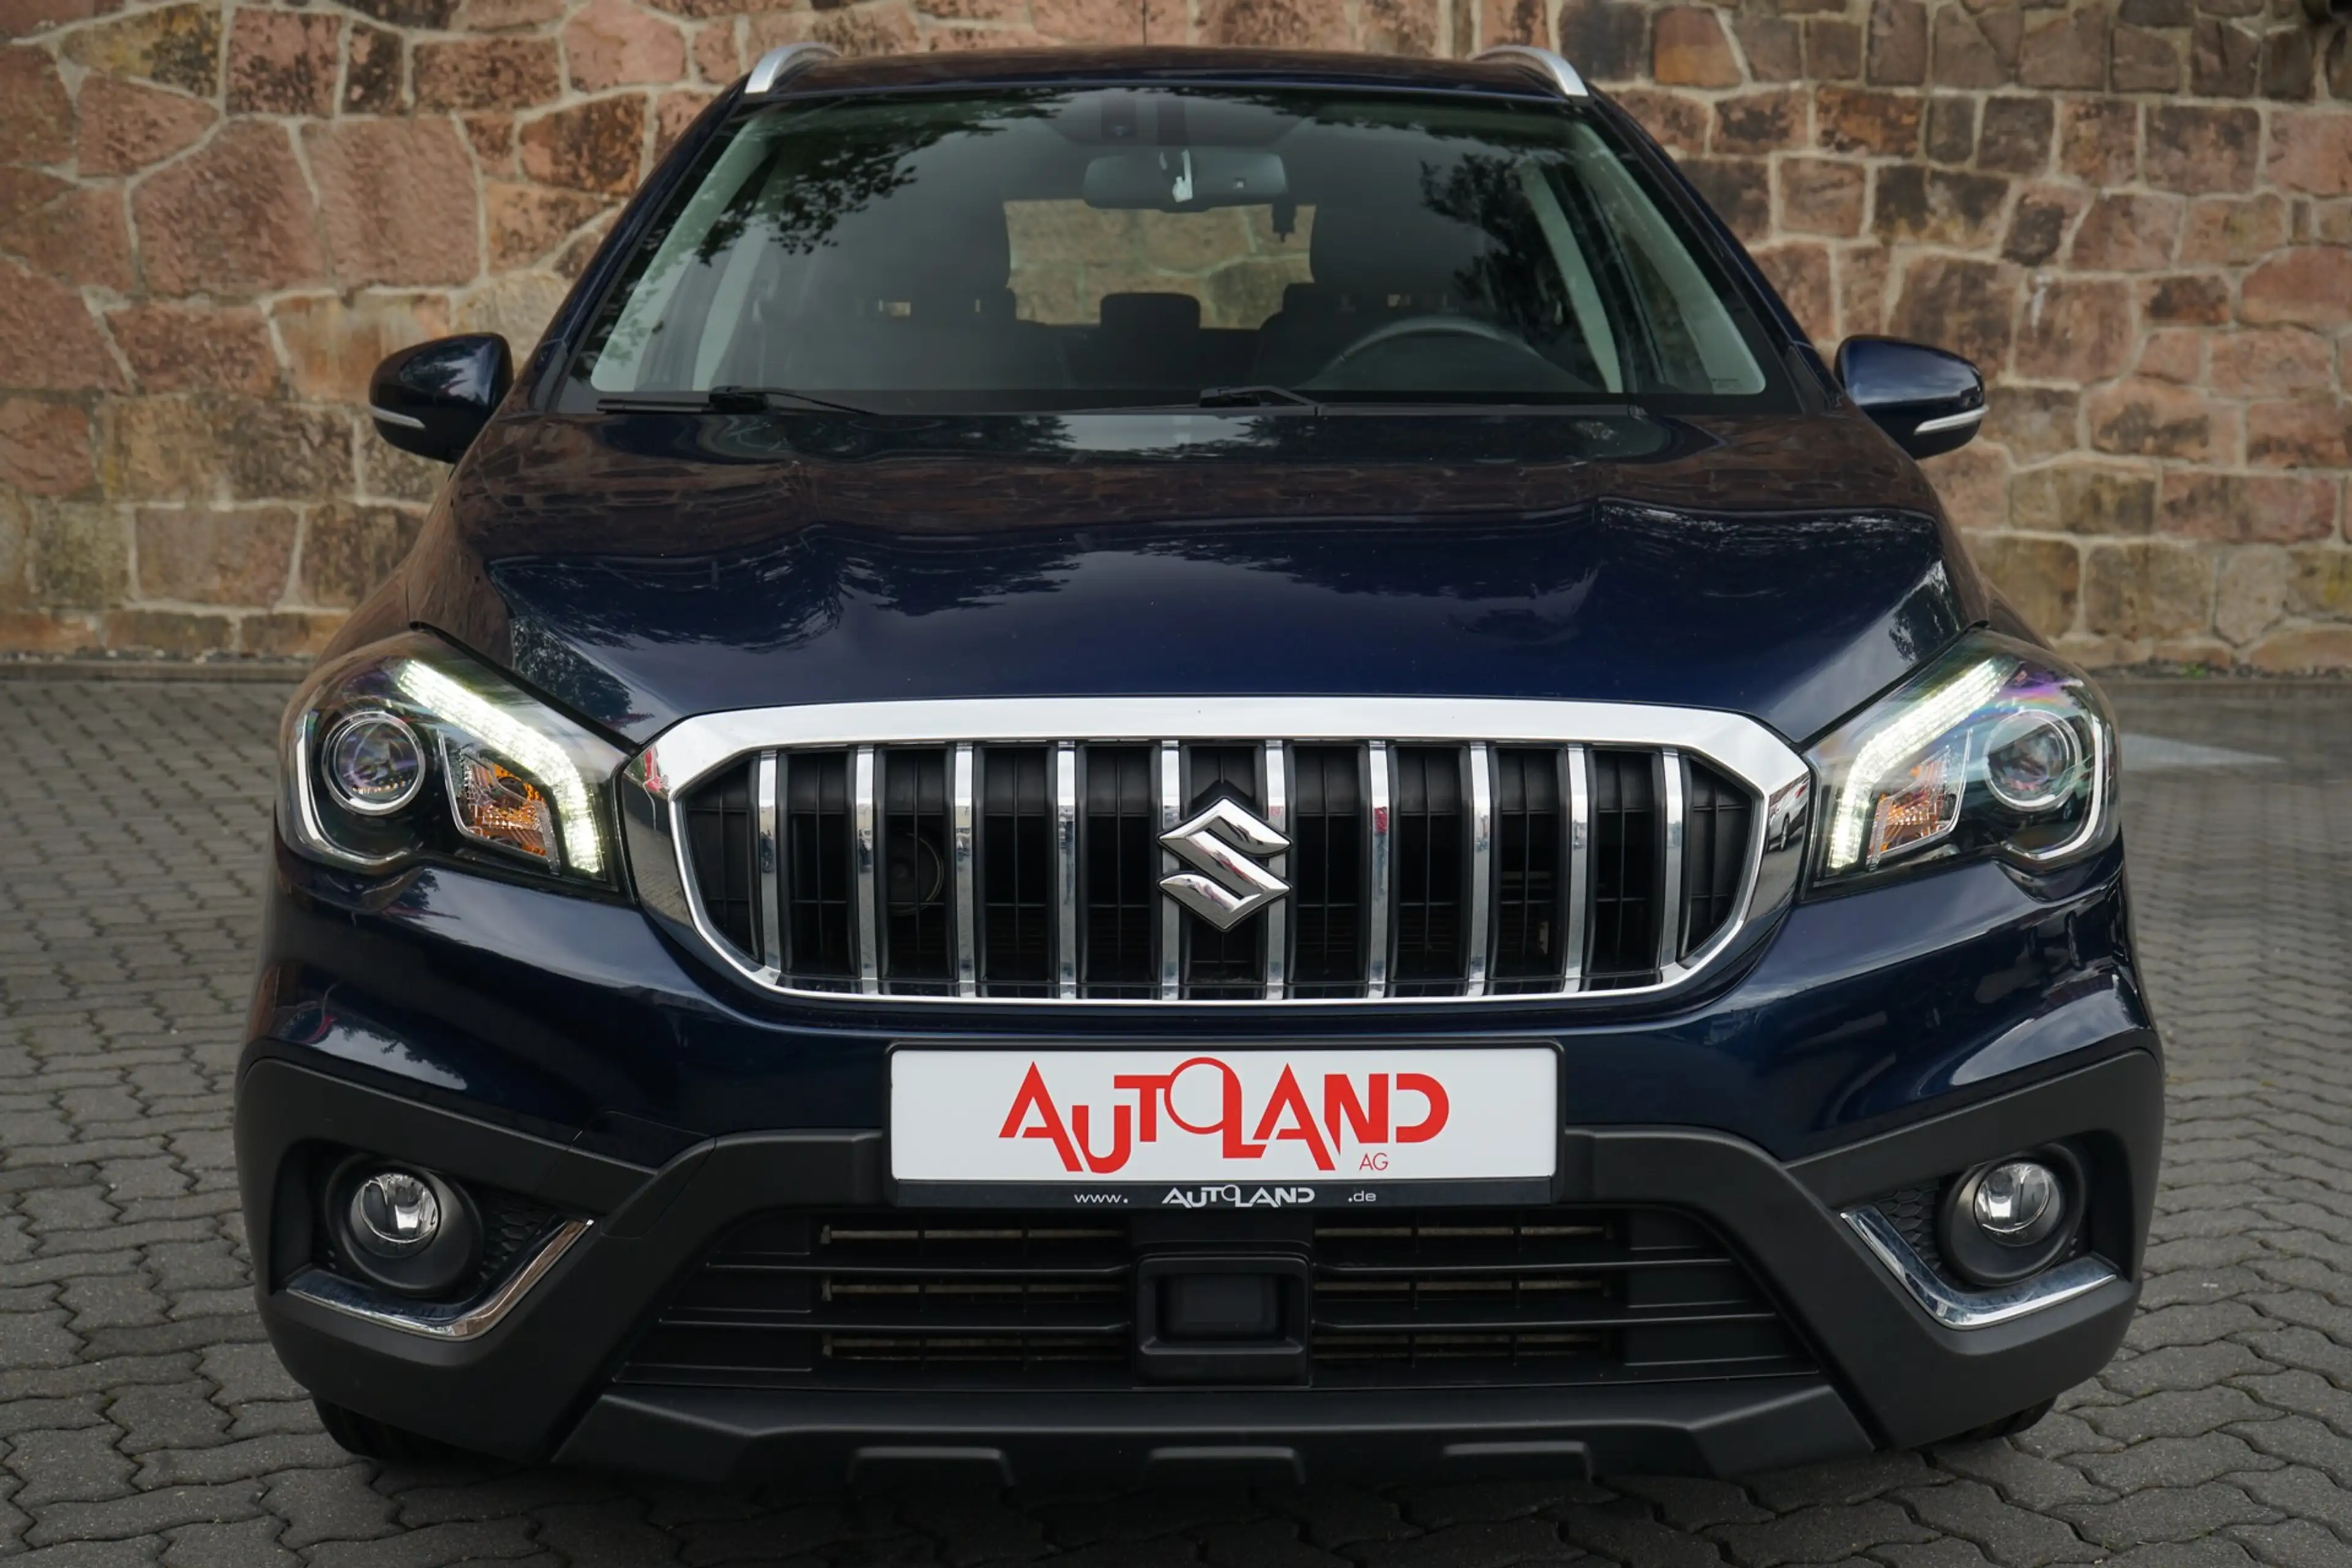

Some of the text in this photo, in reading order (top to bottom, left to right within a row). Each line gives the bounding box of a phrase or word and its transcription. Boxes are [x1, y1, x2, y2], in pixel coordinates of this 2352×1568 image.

[999, 1057, 1450, 1174] AUTOLAND
[1359, 1153, 1389, 1170] AG
[1074, 1184, 1376, 1208] www. AUTOLAND .de
